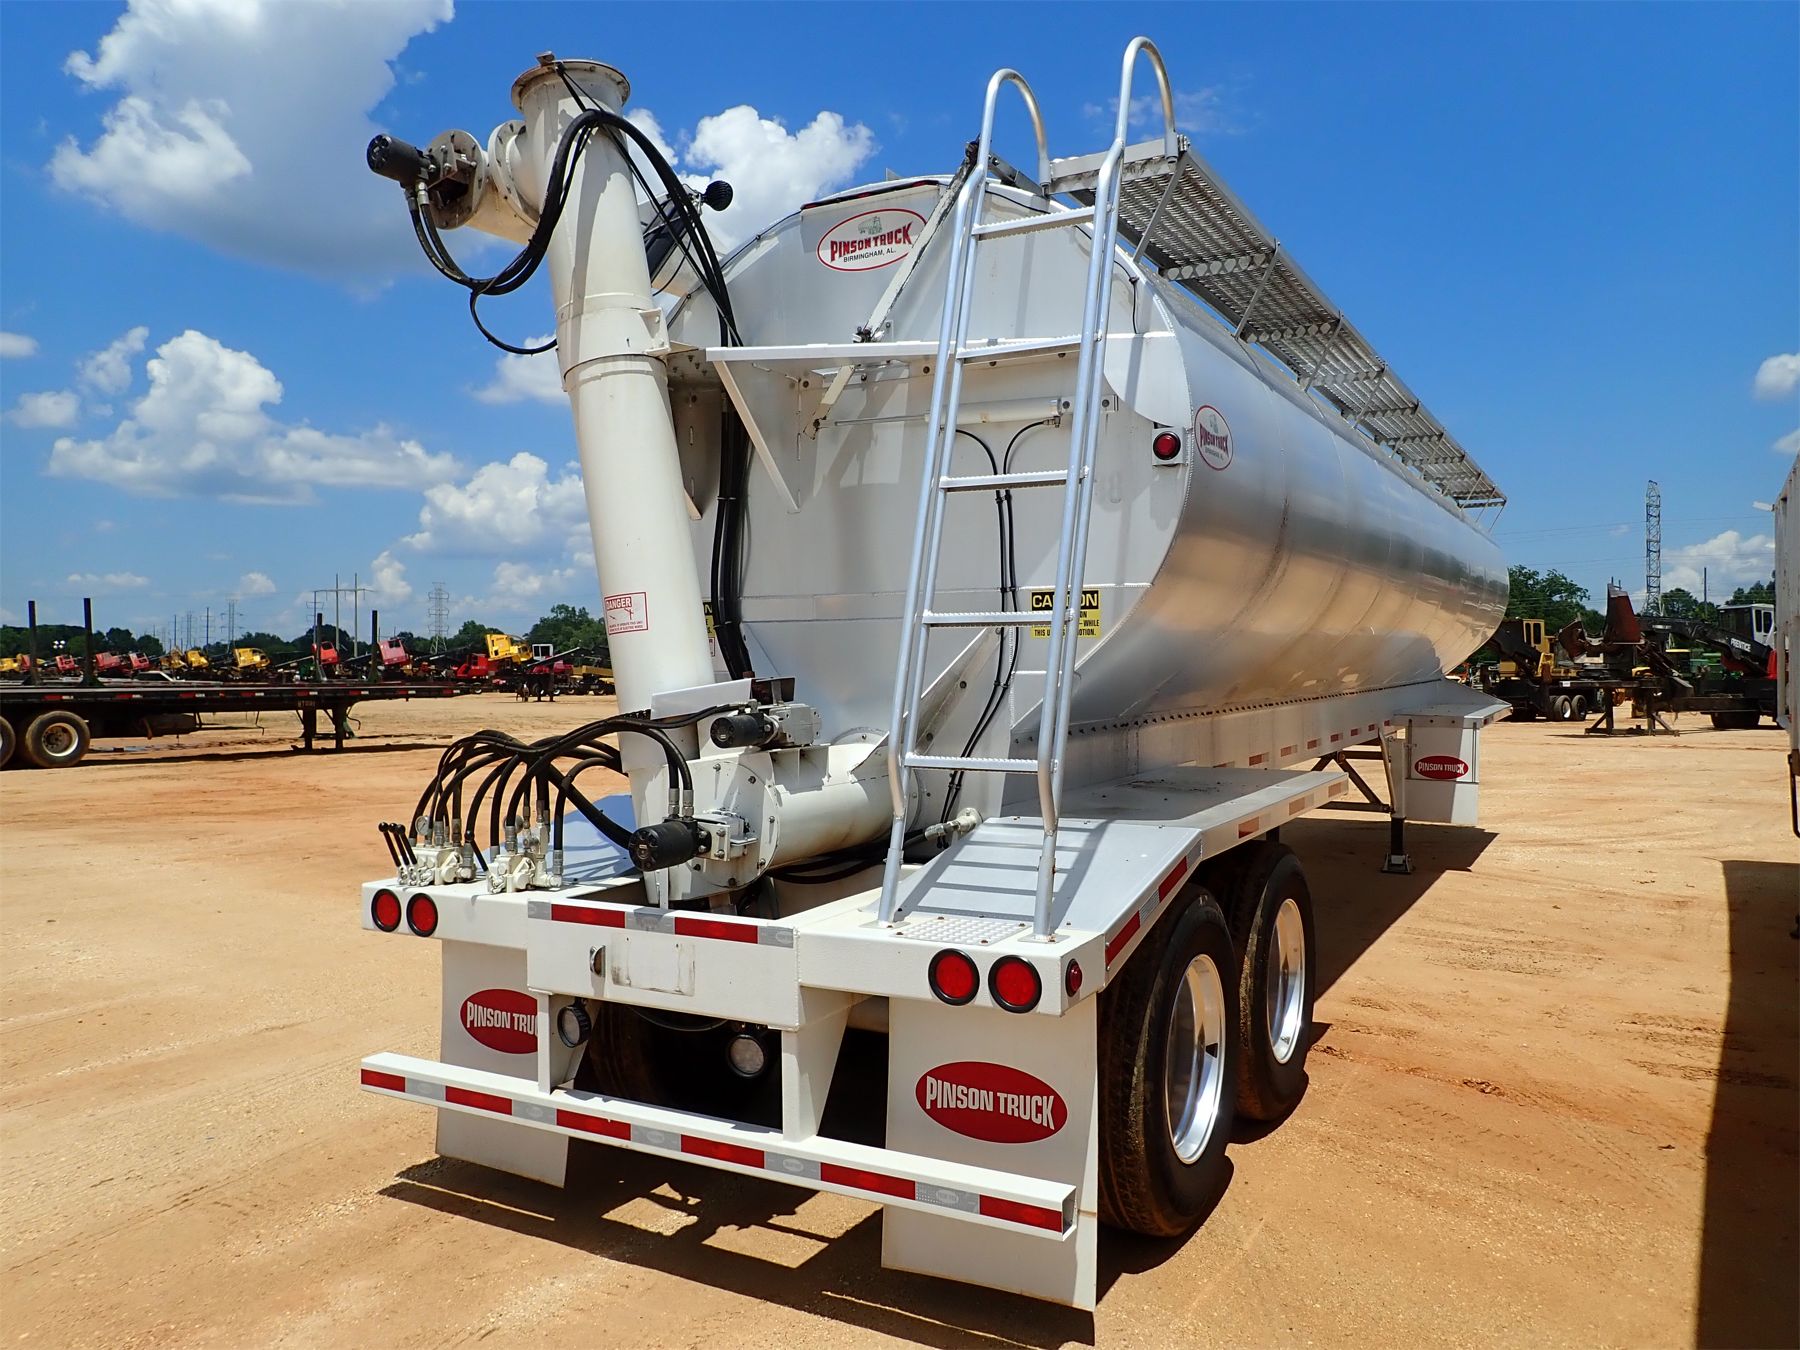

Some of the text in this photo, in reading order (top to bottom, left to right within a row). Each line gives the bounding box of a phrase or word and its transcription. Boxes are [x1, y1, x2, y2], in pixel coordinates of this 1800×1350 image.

[830, 221, 914, 262] PINSON TRUCK
[843, 249, 885, 262] BIRMINGHAM,
[605, 598, 632, 610] DANGER
[1417, 761, 1465, 775] PINSON TRUCK
[466, 1000, 538, 1036] PINSON TRU
[925, 1075, 1055, 1130] PINSON TRUCK
